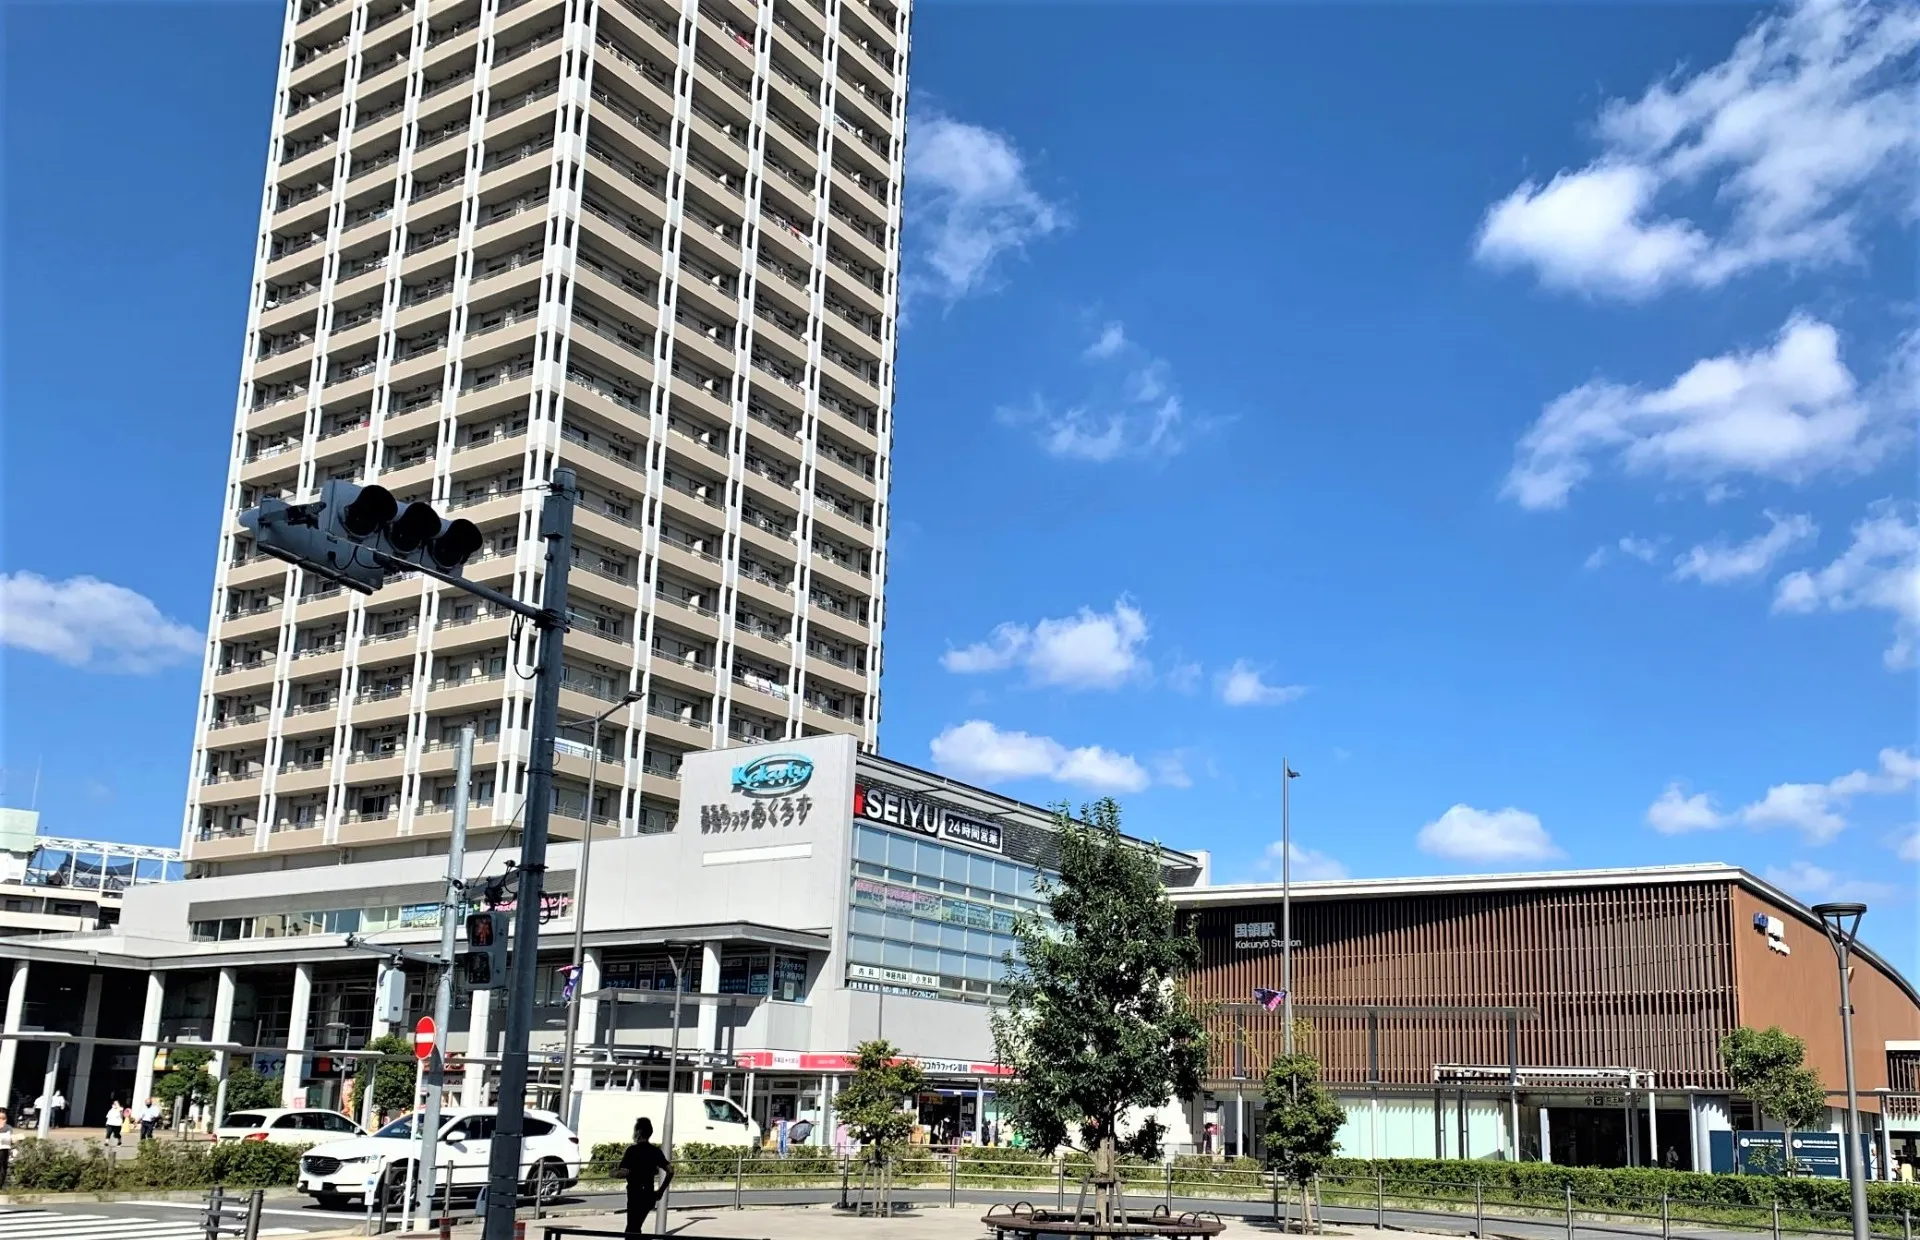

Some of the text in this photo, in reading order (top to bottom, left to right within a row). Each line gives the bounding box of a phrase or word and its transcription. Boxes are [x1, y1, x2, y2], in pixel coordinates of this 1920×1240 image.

[866, 788, 938, 833] SEIYU
[948, 818, 998, 845] 24時間営業
[1235, 922, 1275, 938] 国領駅
[1235, 939, 1301, 949] Kokuryō Staion
